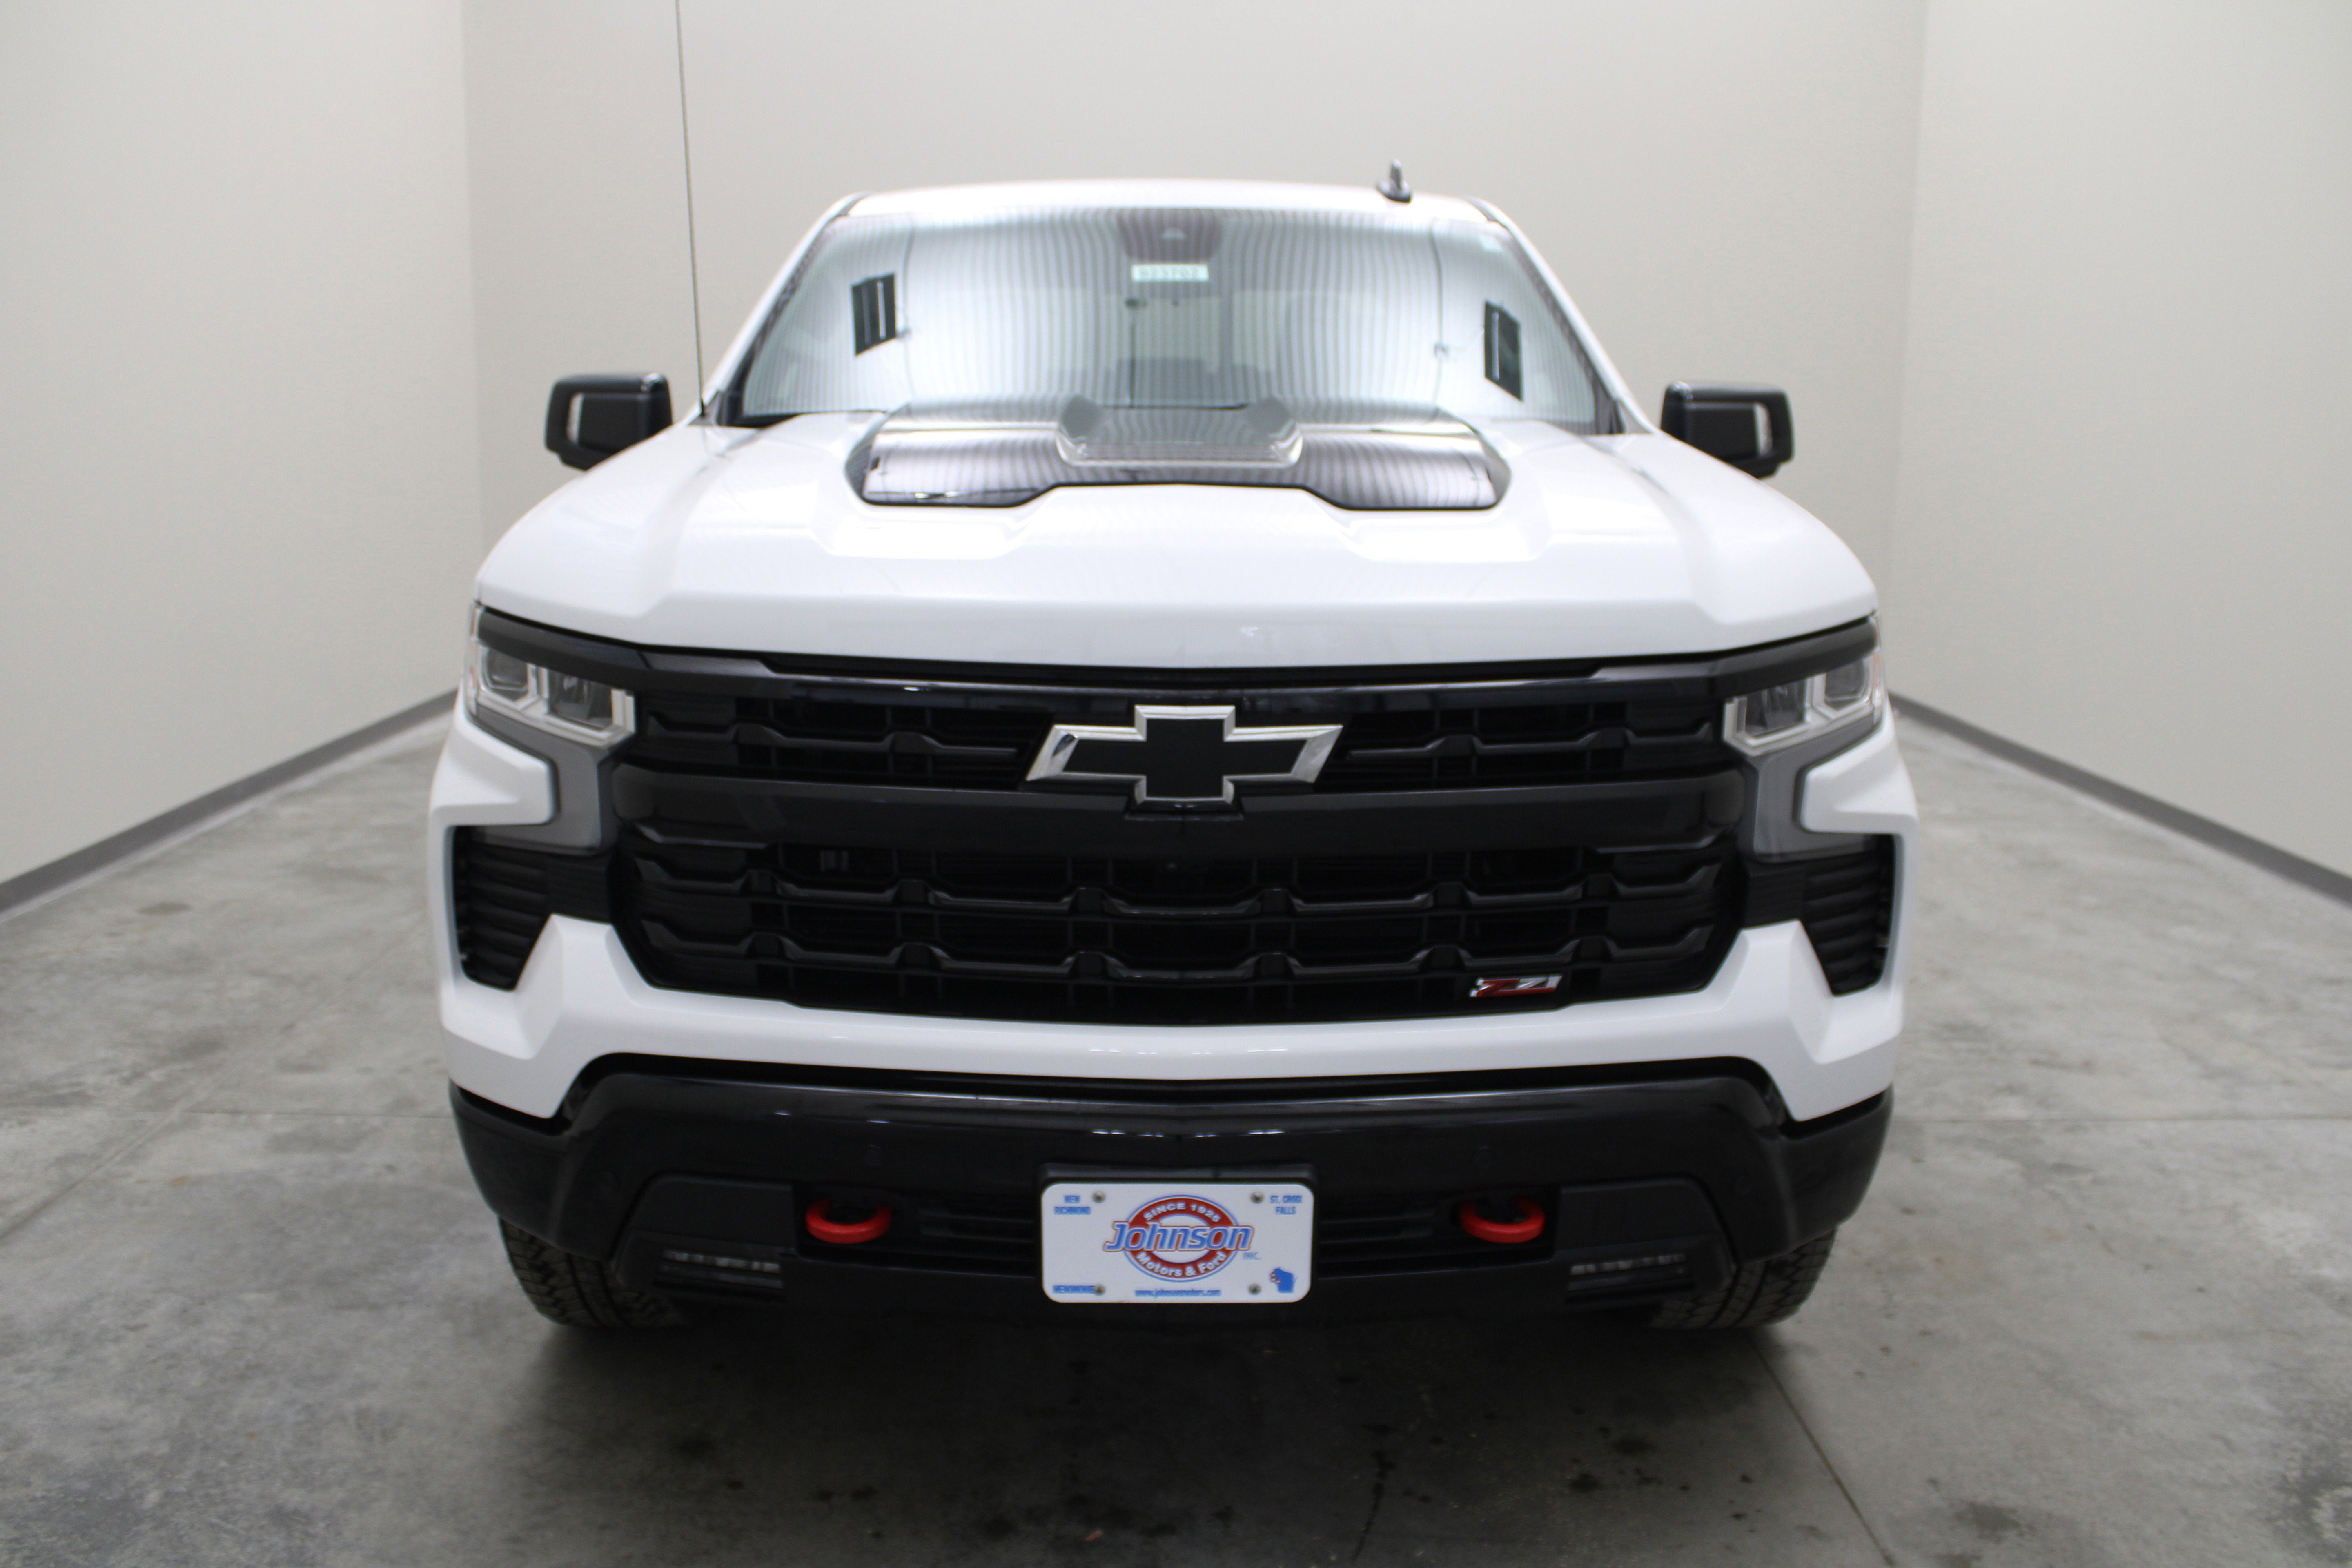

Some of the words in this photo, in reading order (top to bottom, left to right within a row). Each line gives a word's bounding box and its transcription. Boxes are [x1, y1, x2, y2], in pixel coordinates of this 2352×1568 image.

[1470, 975, 1562, 997] Z71
[1144, 1203, 1185, 1221] SINCE
[1104, 1221, 1254, 1252] Johnson
[1136, 1252, 1183, 1277] Motors
[1185, 1266, 1197, 1276] &
[1198, 1252, 1227, 1273] Ford
